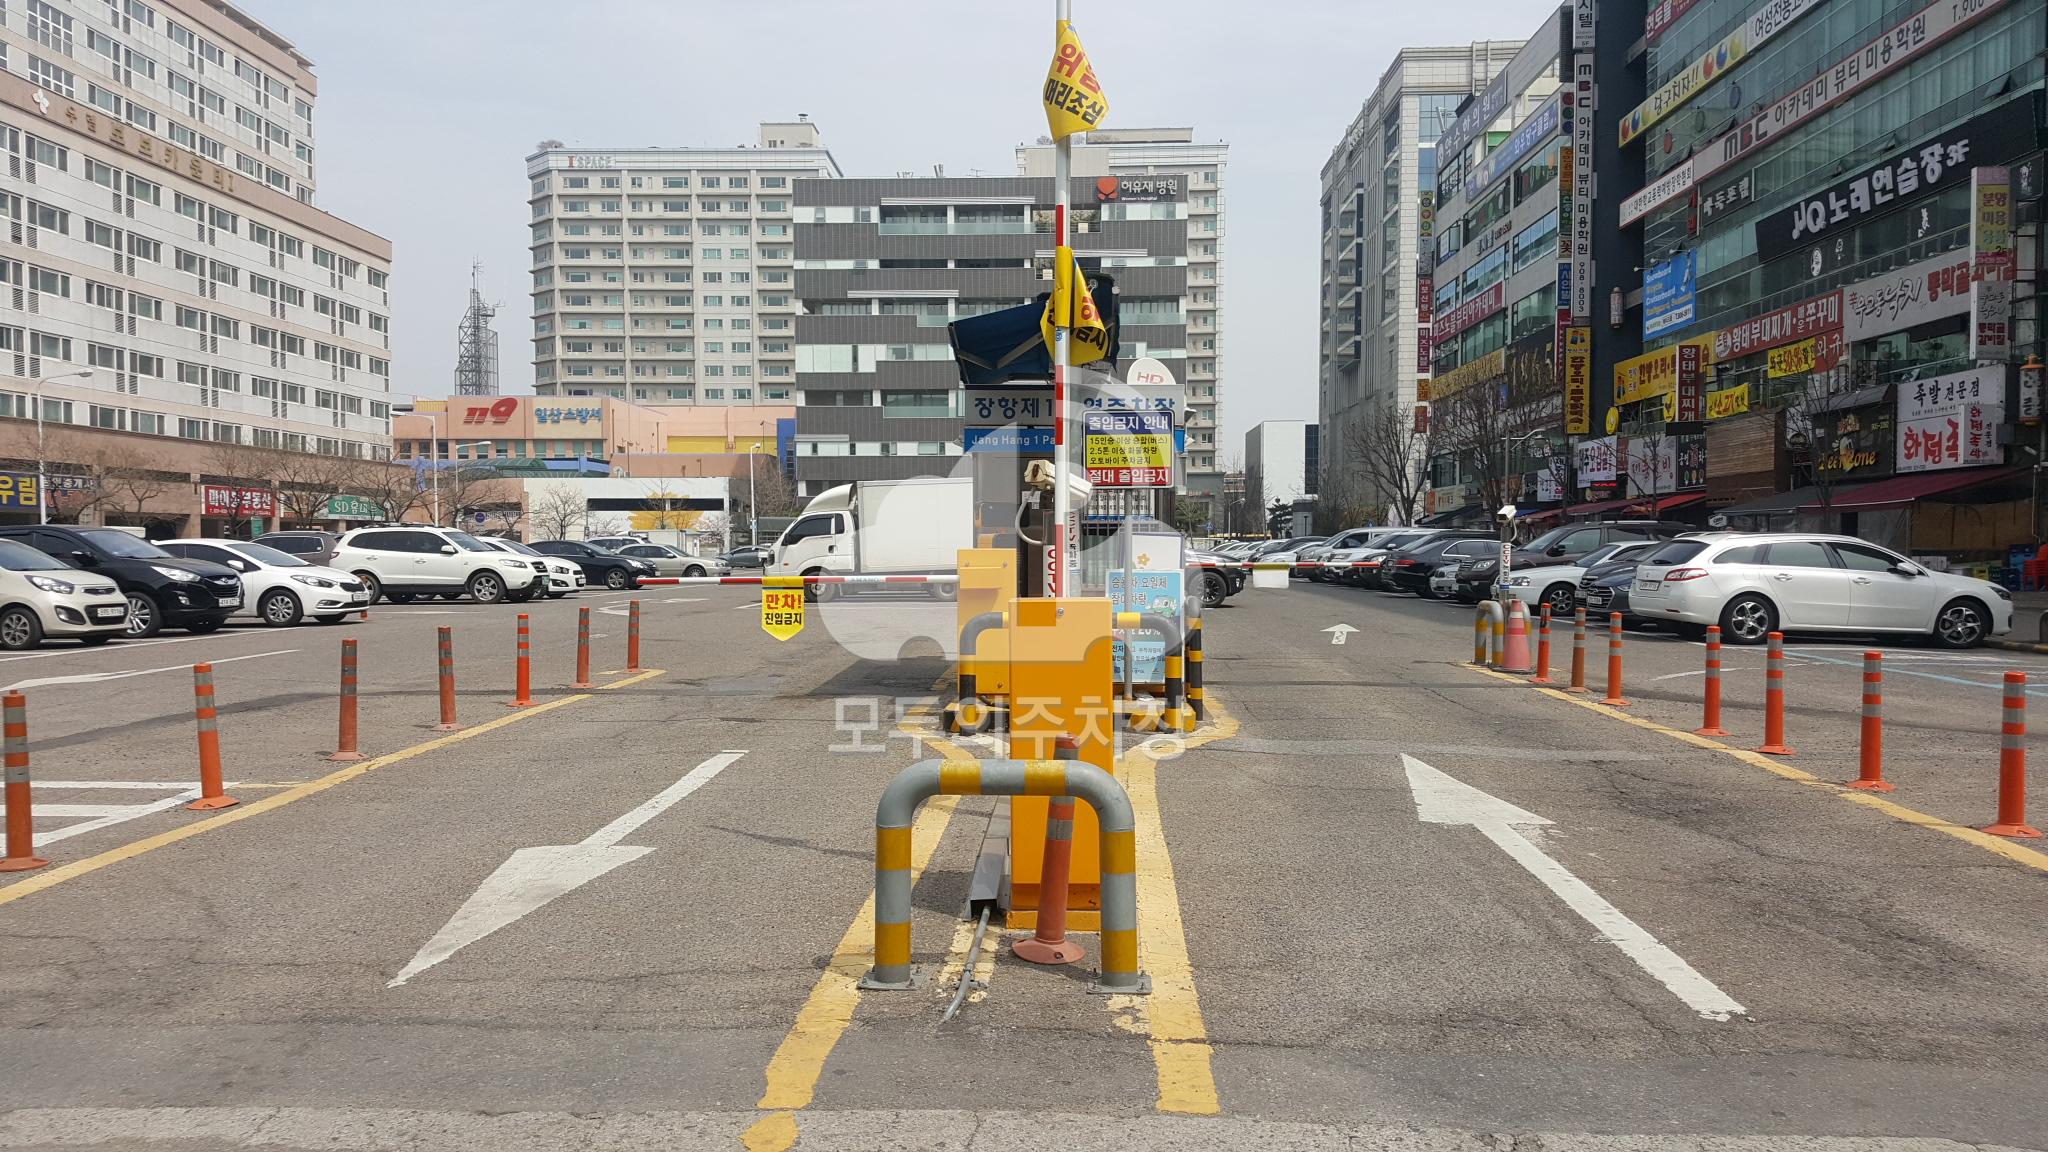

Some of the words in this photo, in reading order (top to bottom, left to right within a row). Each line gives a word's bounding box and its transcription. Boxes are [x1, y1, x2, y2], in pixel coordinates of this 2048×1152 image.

[1654, 65, 1699, 115] 당구치자!!
[1723, 114, 1768, 161] MBC
[1774, 76, 1828, 125] 아카데미
[1834, 56, 1860, 94] 뷰티
[1866, 14, 1926, 70] 미용학원
[1044, 78, 1105, 125] 머리조심
[1578, 116, 1591, 168] 아카데미
[1121, 180, 1154, 194] 허유재
[1156, 179, 1178, 195] 병원
[1577, 174, 1590, 199] 뷰티
[1828, 142, 1946, 225] 노래연습장
[1946, 139, 1970, 167] 3F
[1577, 203, 1590, 255] 미용학원
[1914, 379, 1941, 408] 족발
[1944, 377, 1980, 402] 전문점
[463, 397, 519, 424] 119
[535, 407, 603, 425] 일산소방서
[1088, 416, 1139, 431] 출입금지
[1143, 415, 1169, 430] 안내
[971, 434, 999, 446] Jang
[1001, 436, 1030, 447] Hang
[1033, 436, 1039, 445] 1
[1042, 437, 1056, 445] Pa
[1089, 469, 1115, 483] 절대
[1118, 469, 1169, 483] 출입금지
[0, 475, 37, 505] 우림
[1141, 576, 1168, 589] 요일제
[765, 594, 802, 610] 만차!
[764, 612, 803, 626] 진입금지
